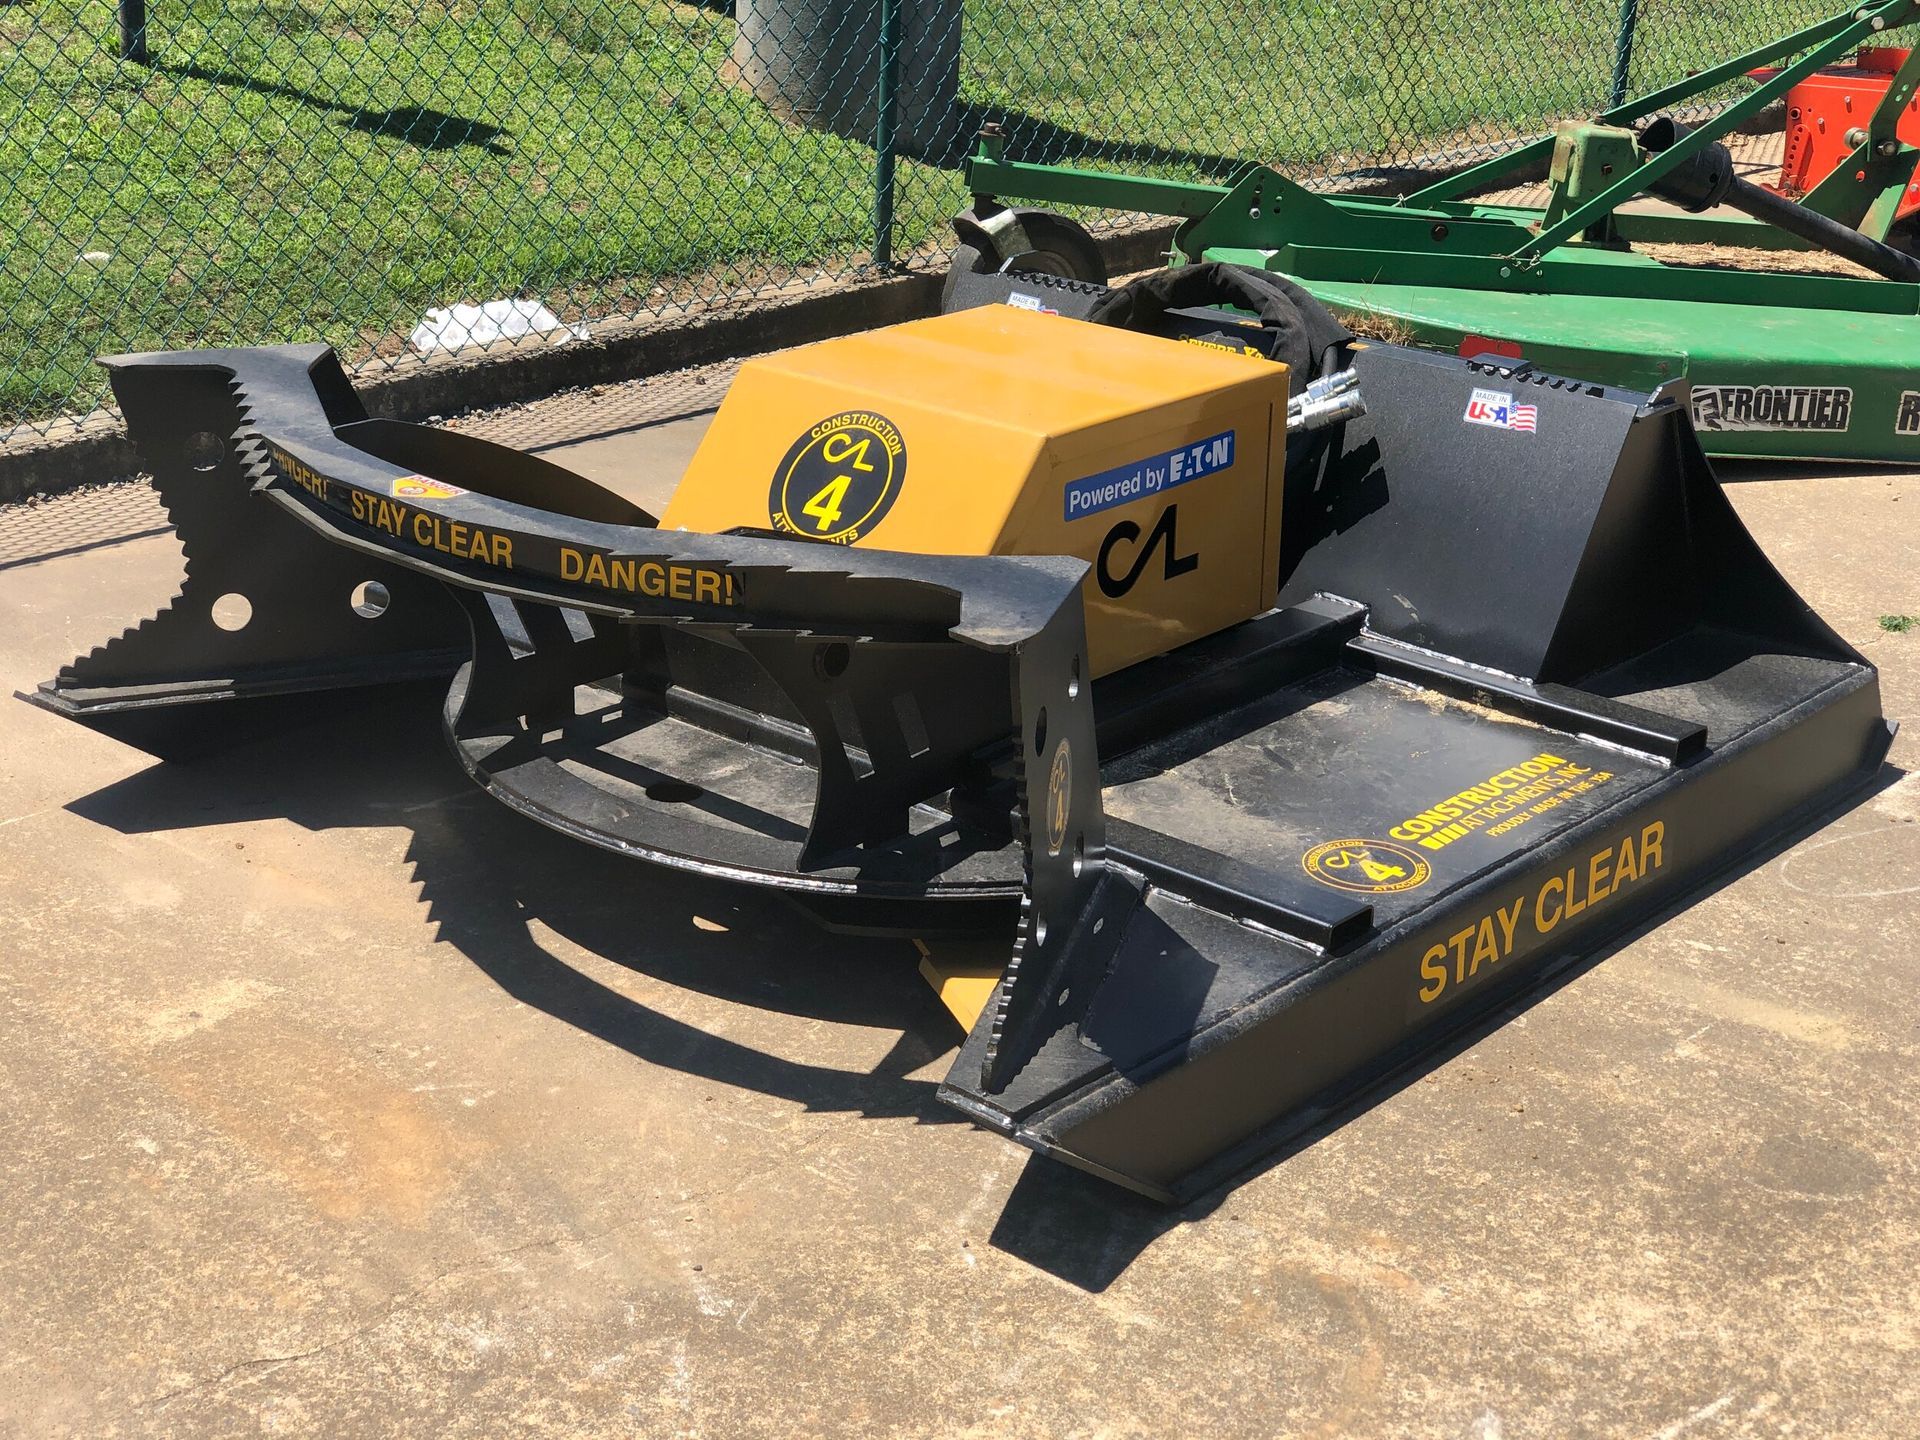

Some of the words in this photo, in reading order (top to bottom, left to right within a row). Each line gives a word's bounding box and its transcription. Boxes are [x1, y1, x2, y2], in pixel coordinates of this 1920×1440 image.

[1012, 294, 1029, 305] MADE
[1029, 298, 1038, 307] IN
[1468, 401, 1508, 424] USA
[1474, 391, 1498, 402] MADE
[1720, 388, 1849, 425] FRONTIER
[811, 413, 903, 456] CONSTRUCTION
[802, 474, 853, 532] 4
[1069, 471, 1141, 514] Powered
[1145, 467, 1166, 491] by
[351, 489, 407, 538] STAY
[413, 512, 513, 569] CLEAR
[560, 547, 734, 606] DANGER!
[1554, 762, 1592, 780] INC
[1389, 752, 1568, 842] CONSTRUCTION
[1485, 811, 1534, 838] PROUDLY
[1528, 796, 1564, 815] MADE
[1568, 780, 1595, 793] THE
[1307, 840, 1364, 873] CONSTRUCTION
[1359, 859, 1407, 882] 4
[1373, 862, 1427, 892] ATTACHMENTS
[1418, 895, 1526, 1004] STAY
[1534, 819, 1666, 934] CLEAR
